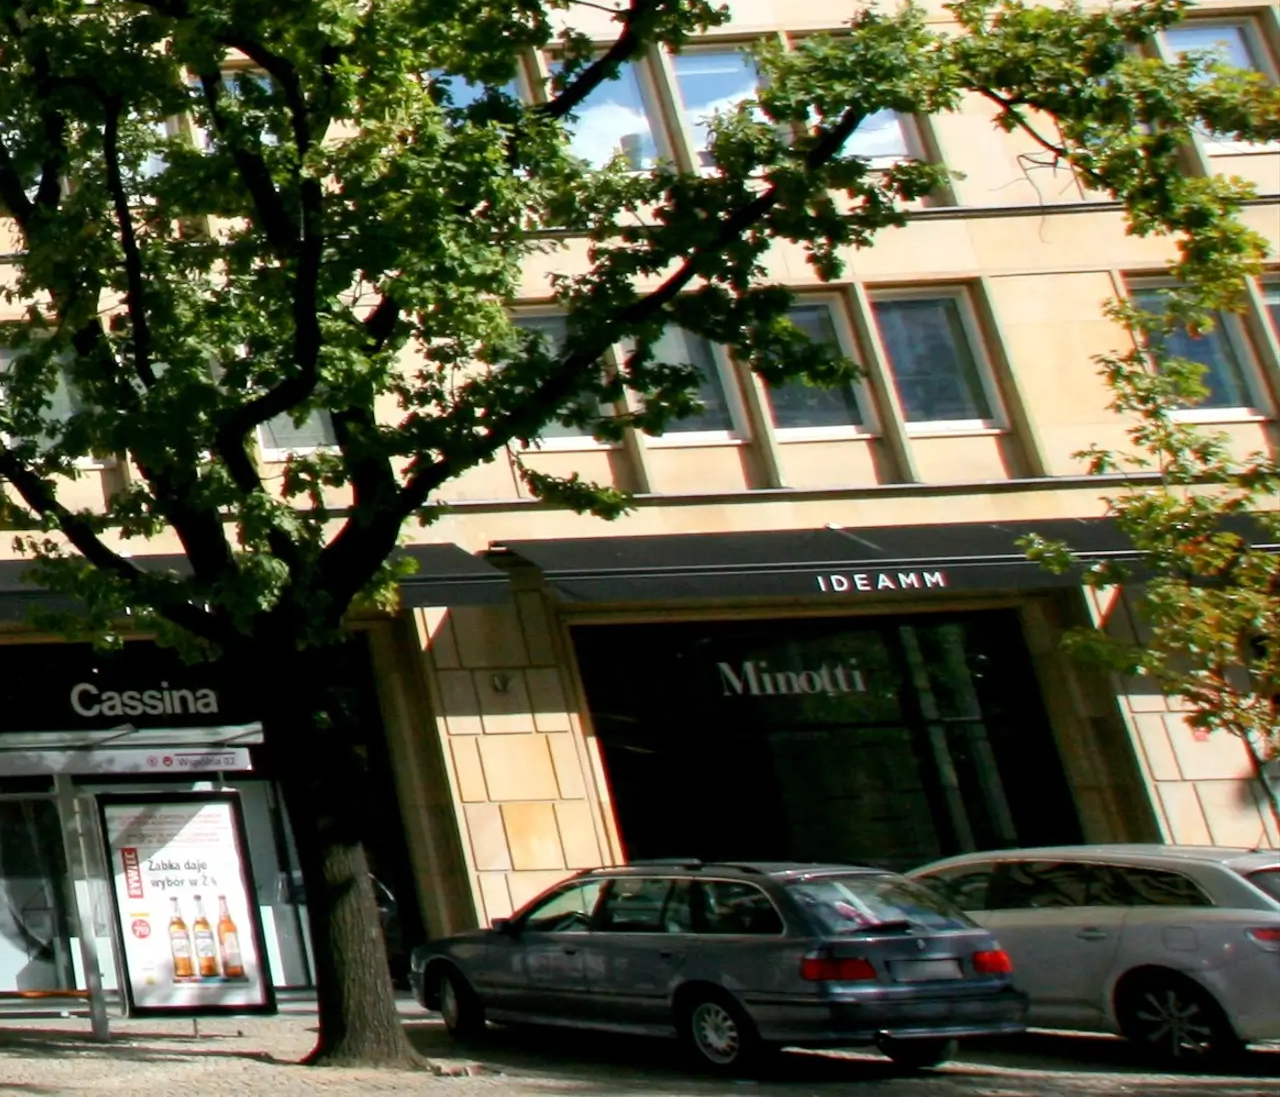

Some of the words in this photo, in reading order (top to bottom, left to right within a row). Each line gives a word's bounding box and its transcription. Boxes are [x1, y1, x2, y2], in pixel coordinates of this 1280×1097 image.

[816, 570, 948, 593] IDEAMM
[717, 658, 867, 697] Minotti
[70, 681, 220, 717] Cassina
